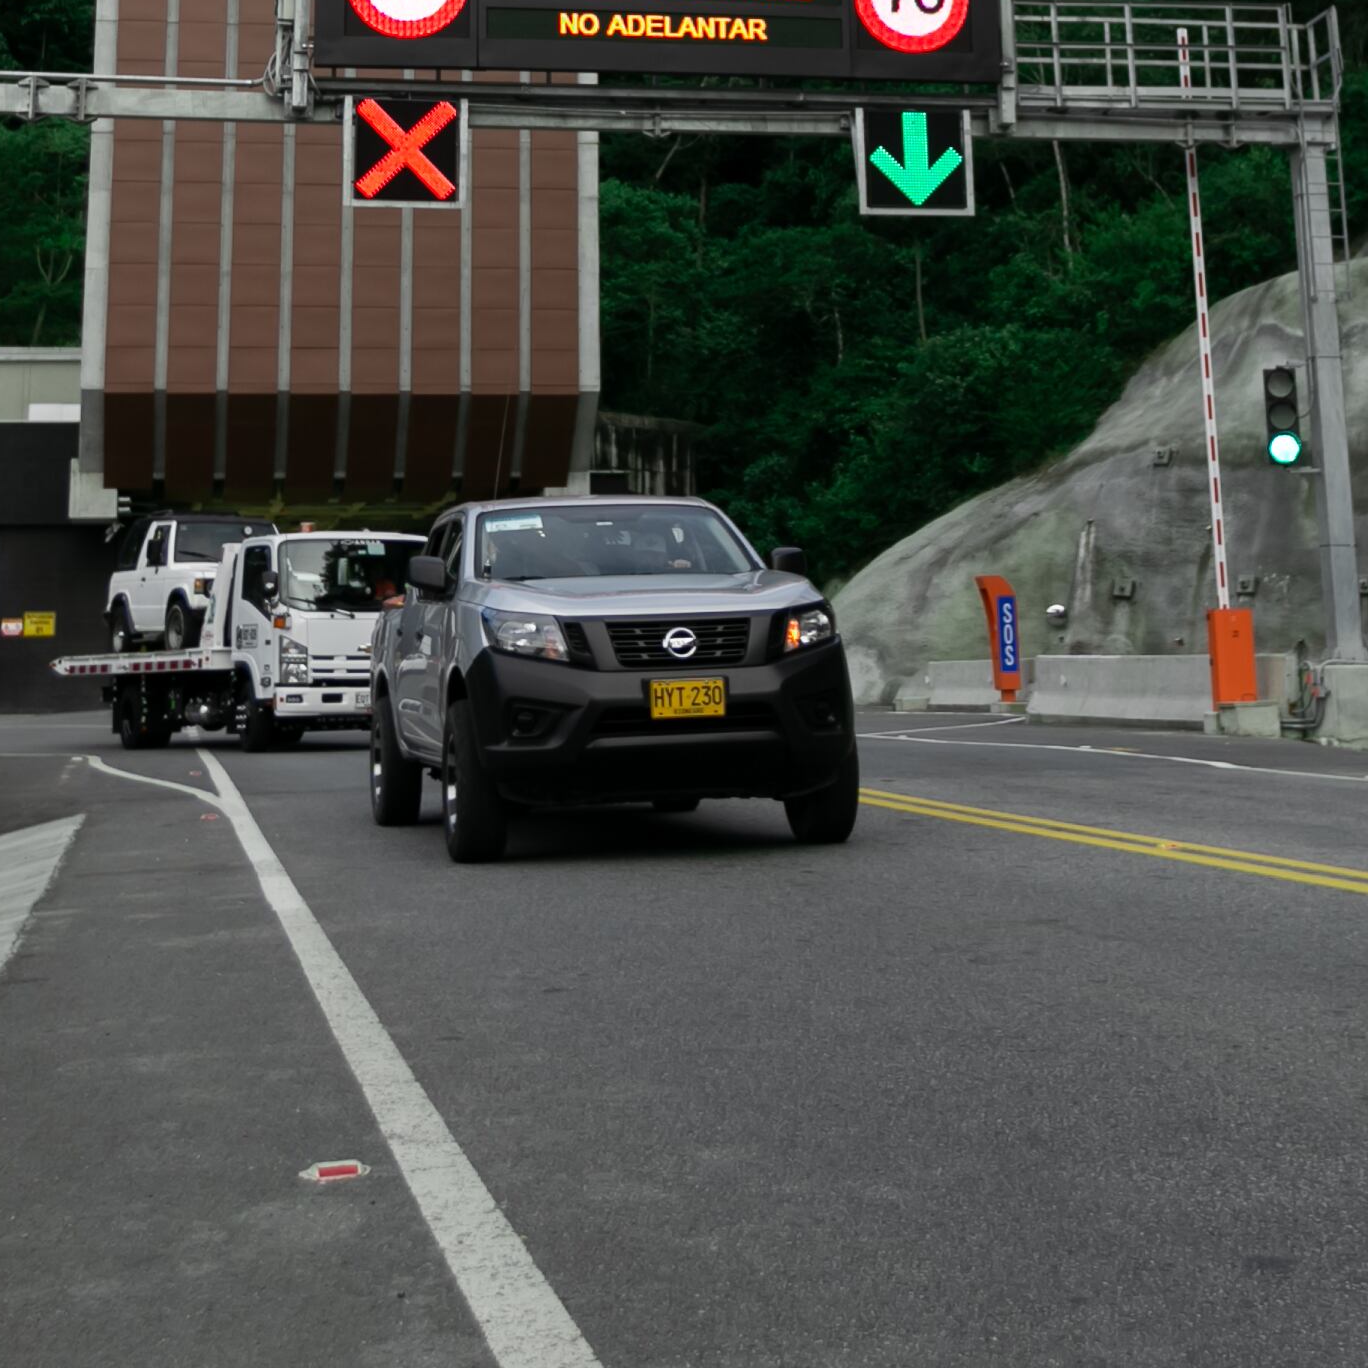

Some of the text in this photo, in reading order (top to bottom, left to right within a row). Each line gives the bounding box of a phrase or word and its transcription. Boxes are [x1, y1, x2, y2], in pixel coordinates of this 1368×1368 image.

[558, 12, 768, 41] NO ADELANTAR
[1002, 602, 1015, 666] SOS
